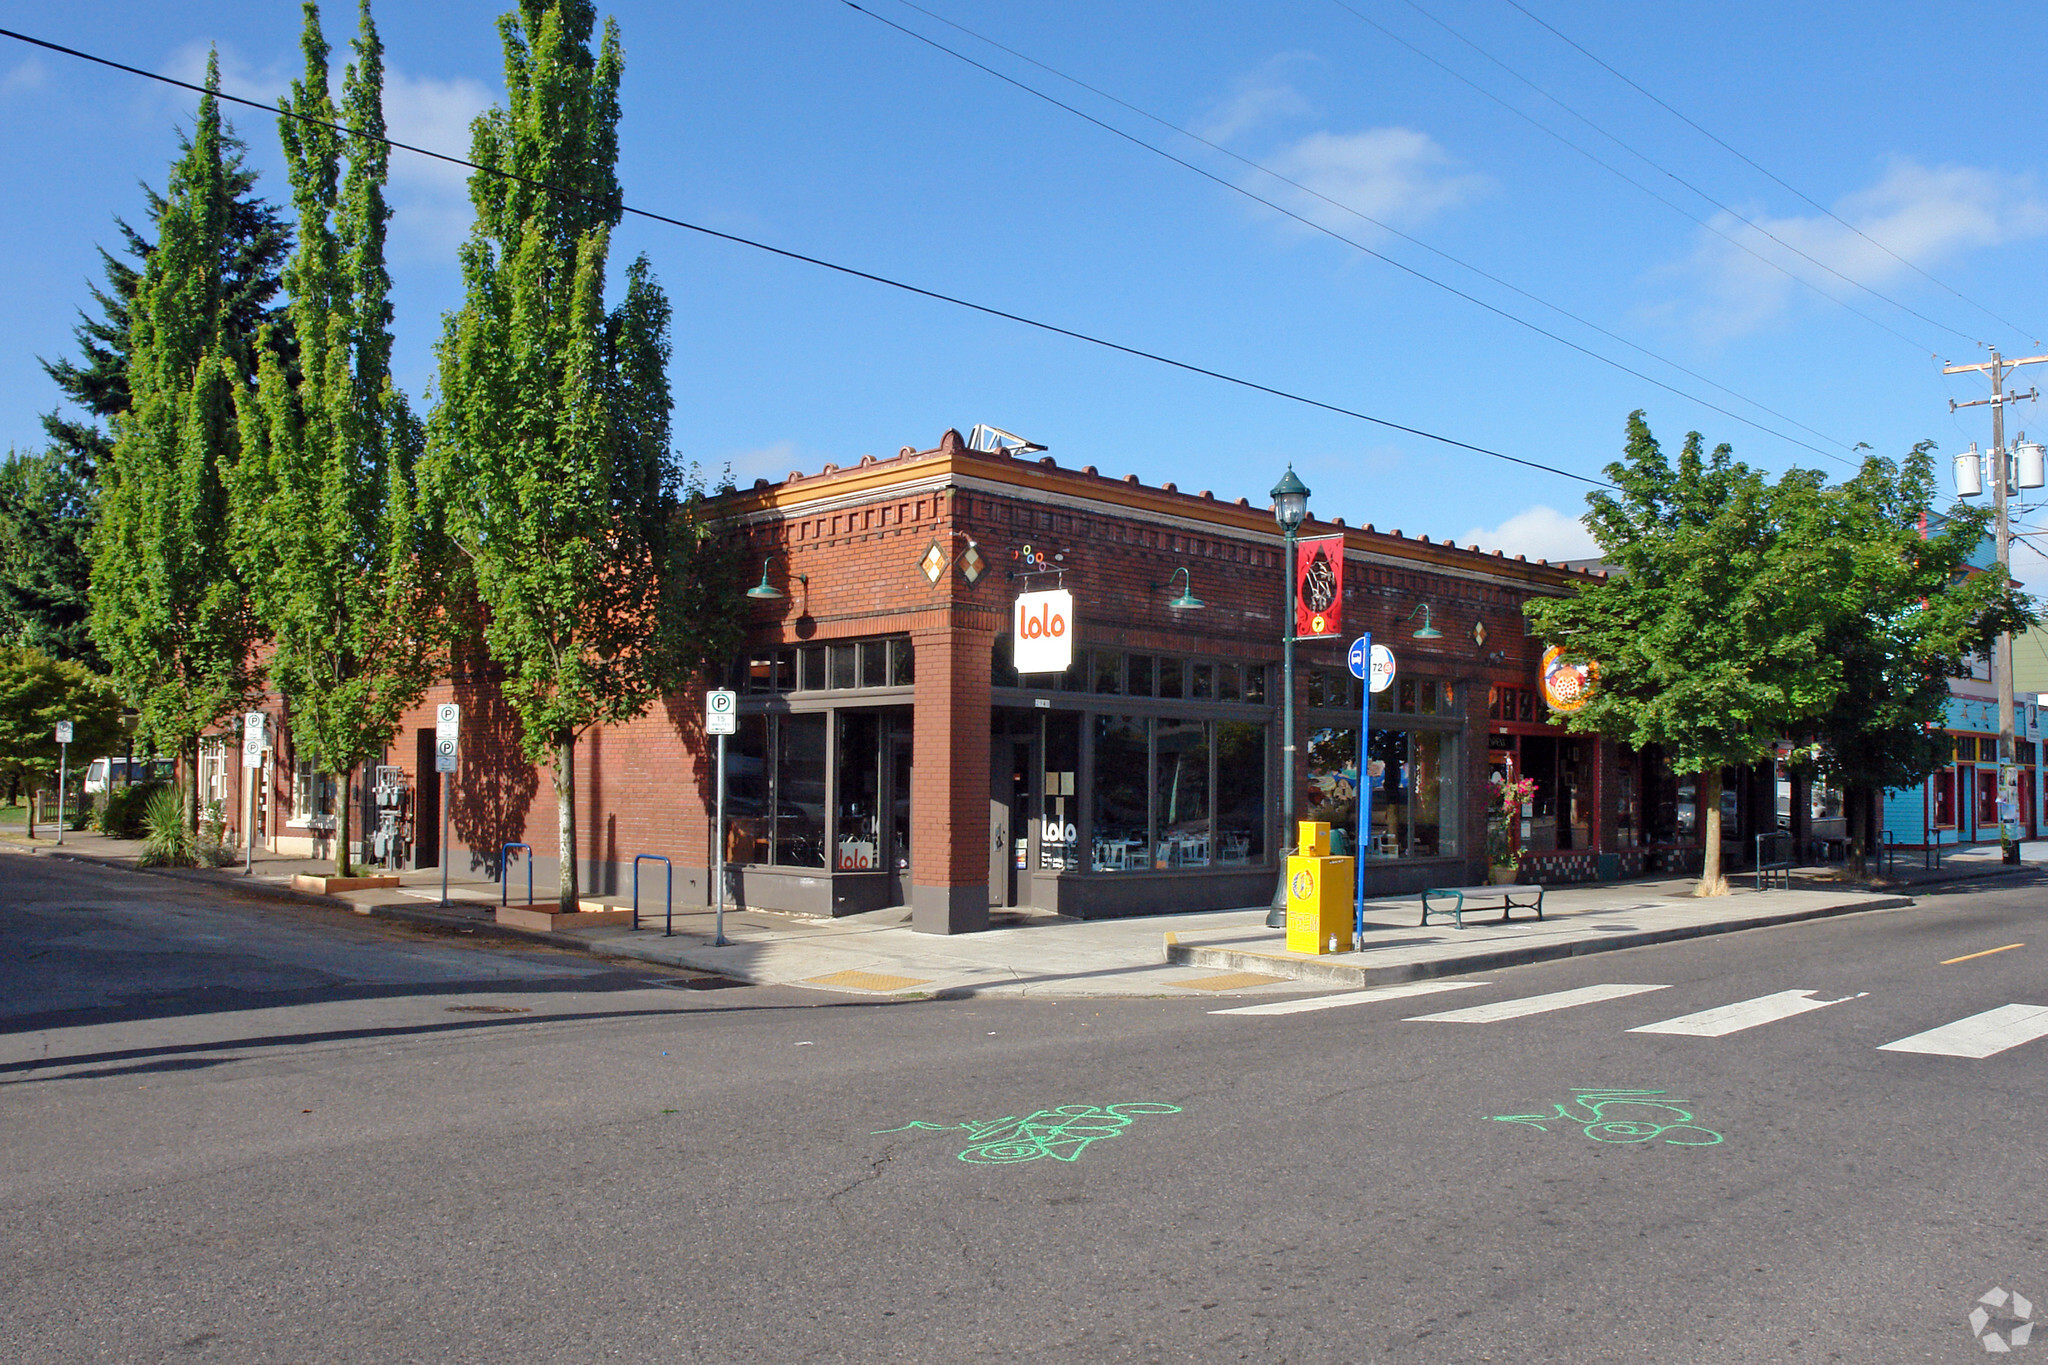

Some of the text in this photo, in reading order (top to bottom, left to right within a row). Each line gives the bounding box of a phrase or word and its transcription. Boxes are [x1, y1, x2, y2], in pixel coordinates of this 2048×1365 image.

[1021, 602, 1065, 639] lolo
[1372, 663, 1383, 672] 72
[717, 697, 727, 709] P
[444, 709, 452, 719] P
[717, 715, 726, 723] 15
[443, 743, 451, 753] P
[1042, 813, 1077, 842] lolo
[838, 848, 868, 870] lolo
